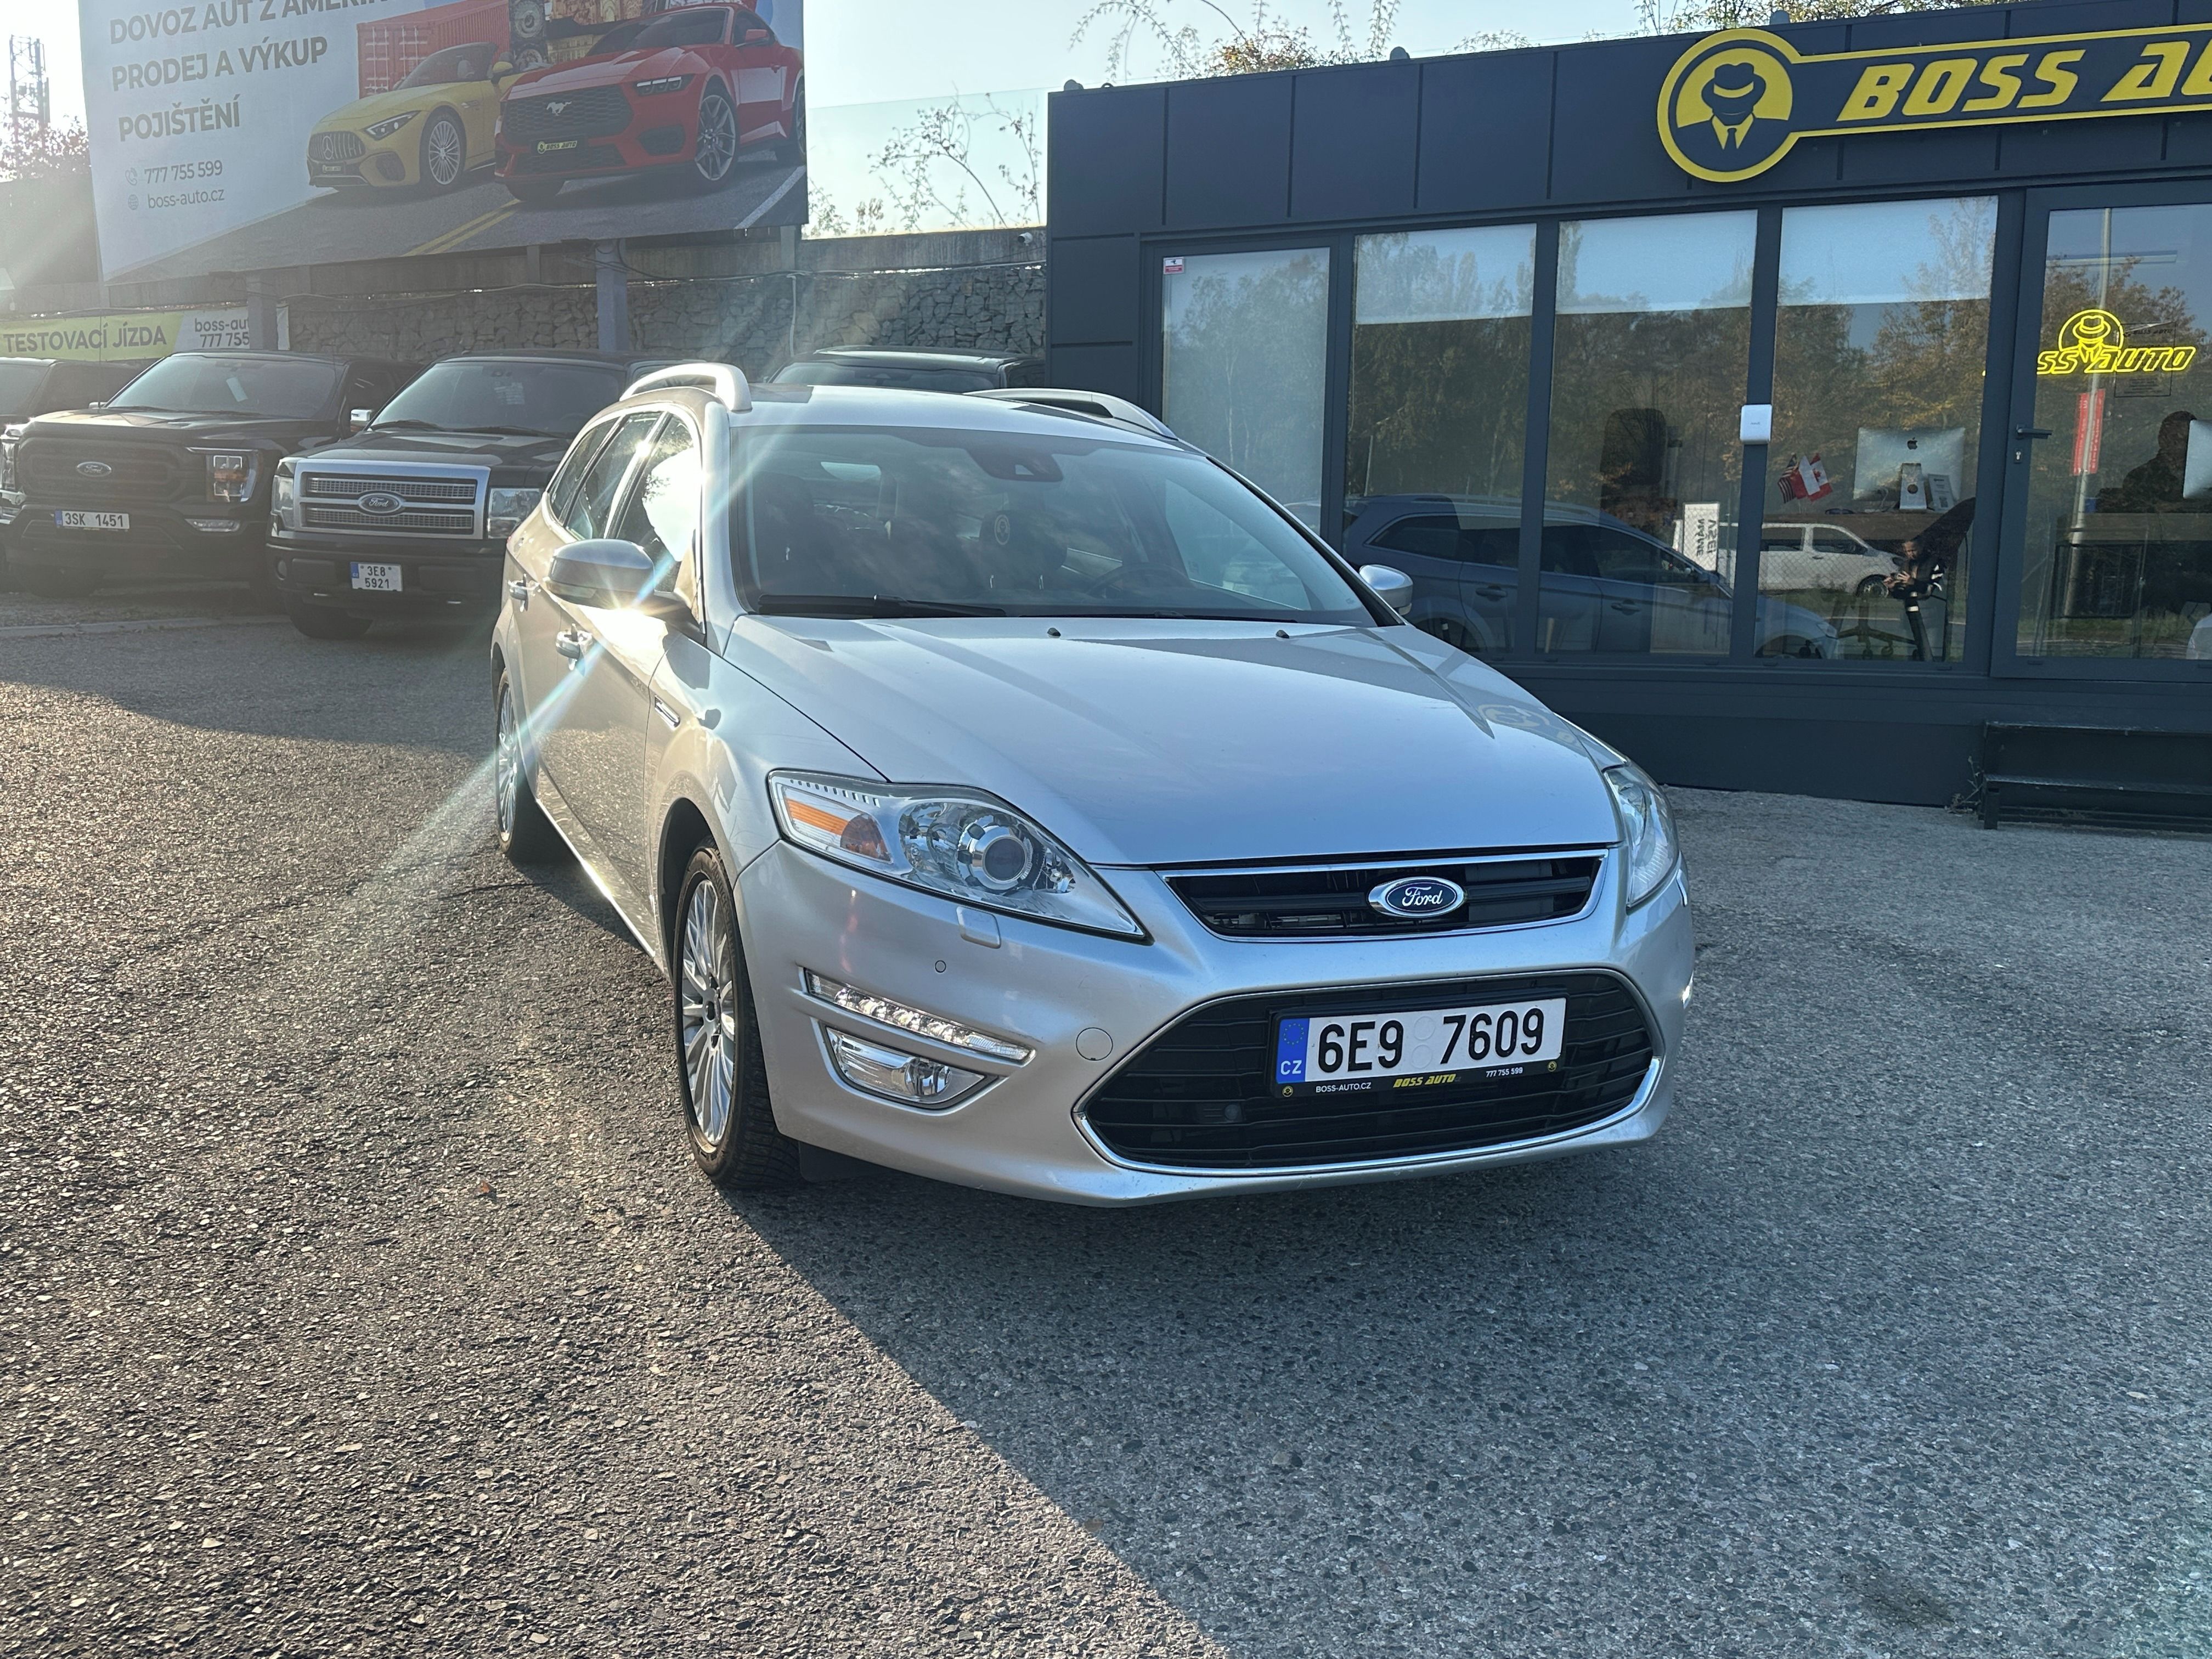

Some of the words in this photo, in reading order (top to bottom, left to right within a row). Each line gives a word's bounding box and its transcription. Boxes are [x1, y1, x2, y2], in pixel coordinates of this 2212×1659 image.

[110, 7, 197, 44] DOVOZ
[202, 0, 253, 30] AUT
[259, 0, 276, 21] Z
[112, 53, 208, 92] PRODEJ
[215, 50, 234, 77] A
[238, 36, 328, 73] VÝKUP
[1836, 49, 2086, 121] BOSS
[119, 94, 241, 142] POJIŠTĚNÍ
[144, 166, 168, 184] 777
[171, 163, 195, 181] 755
[198, 160, 223, 178] 599
[147, 189, 225, 209] boss-auto.cz
[3, 322, 108, 353] TESTOVACÍ
[112, 321, 167, 348] JÍZDA
[200, 333, 222, 348] 777
[225, 331, 250, 347] 755
[2036, 351, 2080, 375] SS
[2084, 346, 2196, 374] AUTO
[369, 497, 389, 507] Ford
[65, 512, 86, 526] 3SK
[95, 514, 123, 527] 1451
[367, 566, 386, 577] 3E8
[365, 578, 390, 589] 5921
[1402, 886, 1443, 907] Ford
[1318, 1019, 1404, 1073] 6E9
[1440, 1007, 1544, 1064] 7609
[1280, 1060, 1302, 1075] CZ
[1316, 1082, 1372, 1093] BOSS-AUTO.CZ
[1393, 1076, 1423, 1088] BOSS
[1425, 1074, 1457, 1085] AUTO
